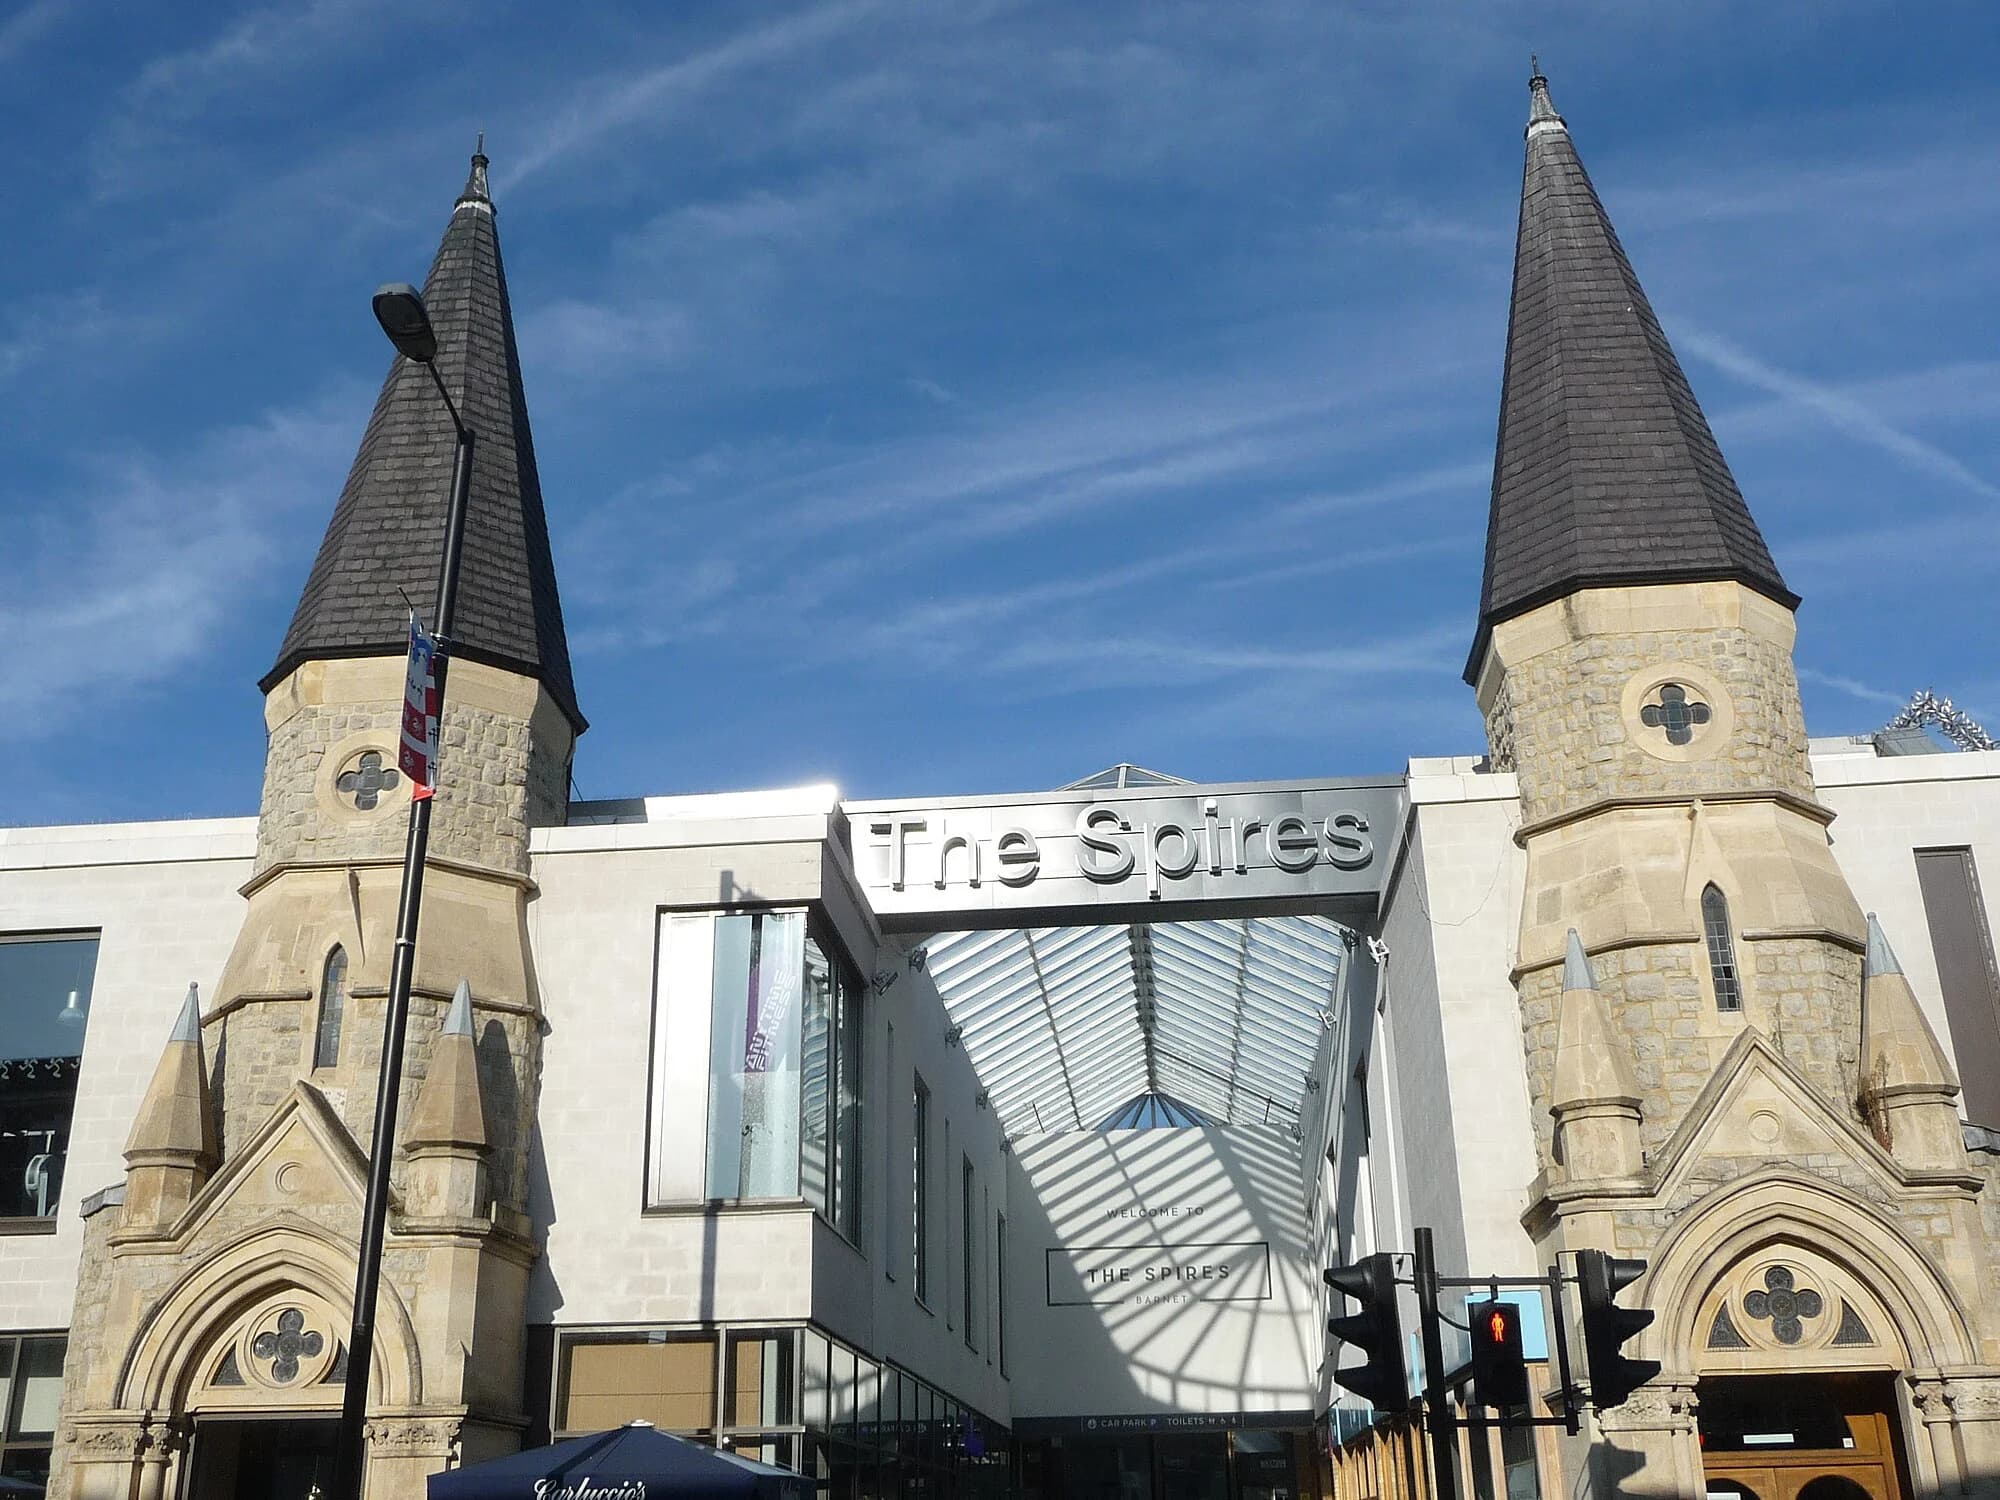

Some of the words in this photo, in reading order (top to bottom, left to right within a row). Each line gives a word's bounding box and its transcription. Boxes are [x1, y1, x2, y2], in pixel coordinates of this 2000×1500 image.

[870, 815, 1041, 892] The
[1076, 798, 1375, 900] Spires
[1107, 1207, 1180, 1218] WELCOME
[1186, 1206, 1204, 1216] TO
[1087, 1268, 1131, 1283] THE
[1144, 1265, 1231, 1281] SPIRES
[1136, 1295, 1188, 1305] BARNET
[1101, 1417, 1121, 1427] CAR
[1123, 1417, 1146, 1427] PARK
[1167, 1416, 1204, 1426] TOILETS
